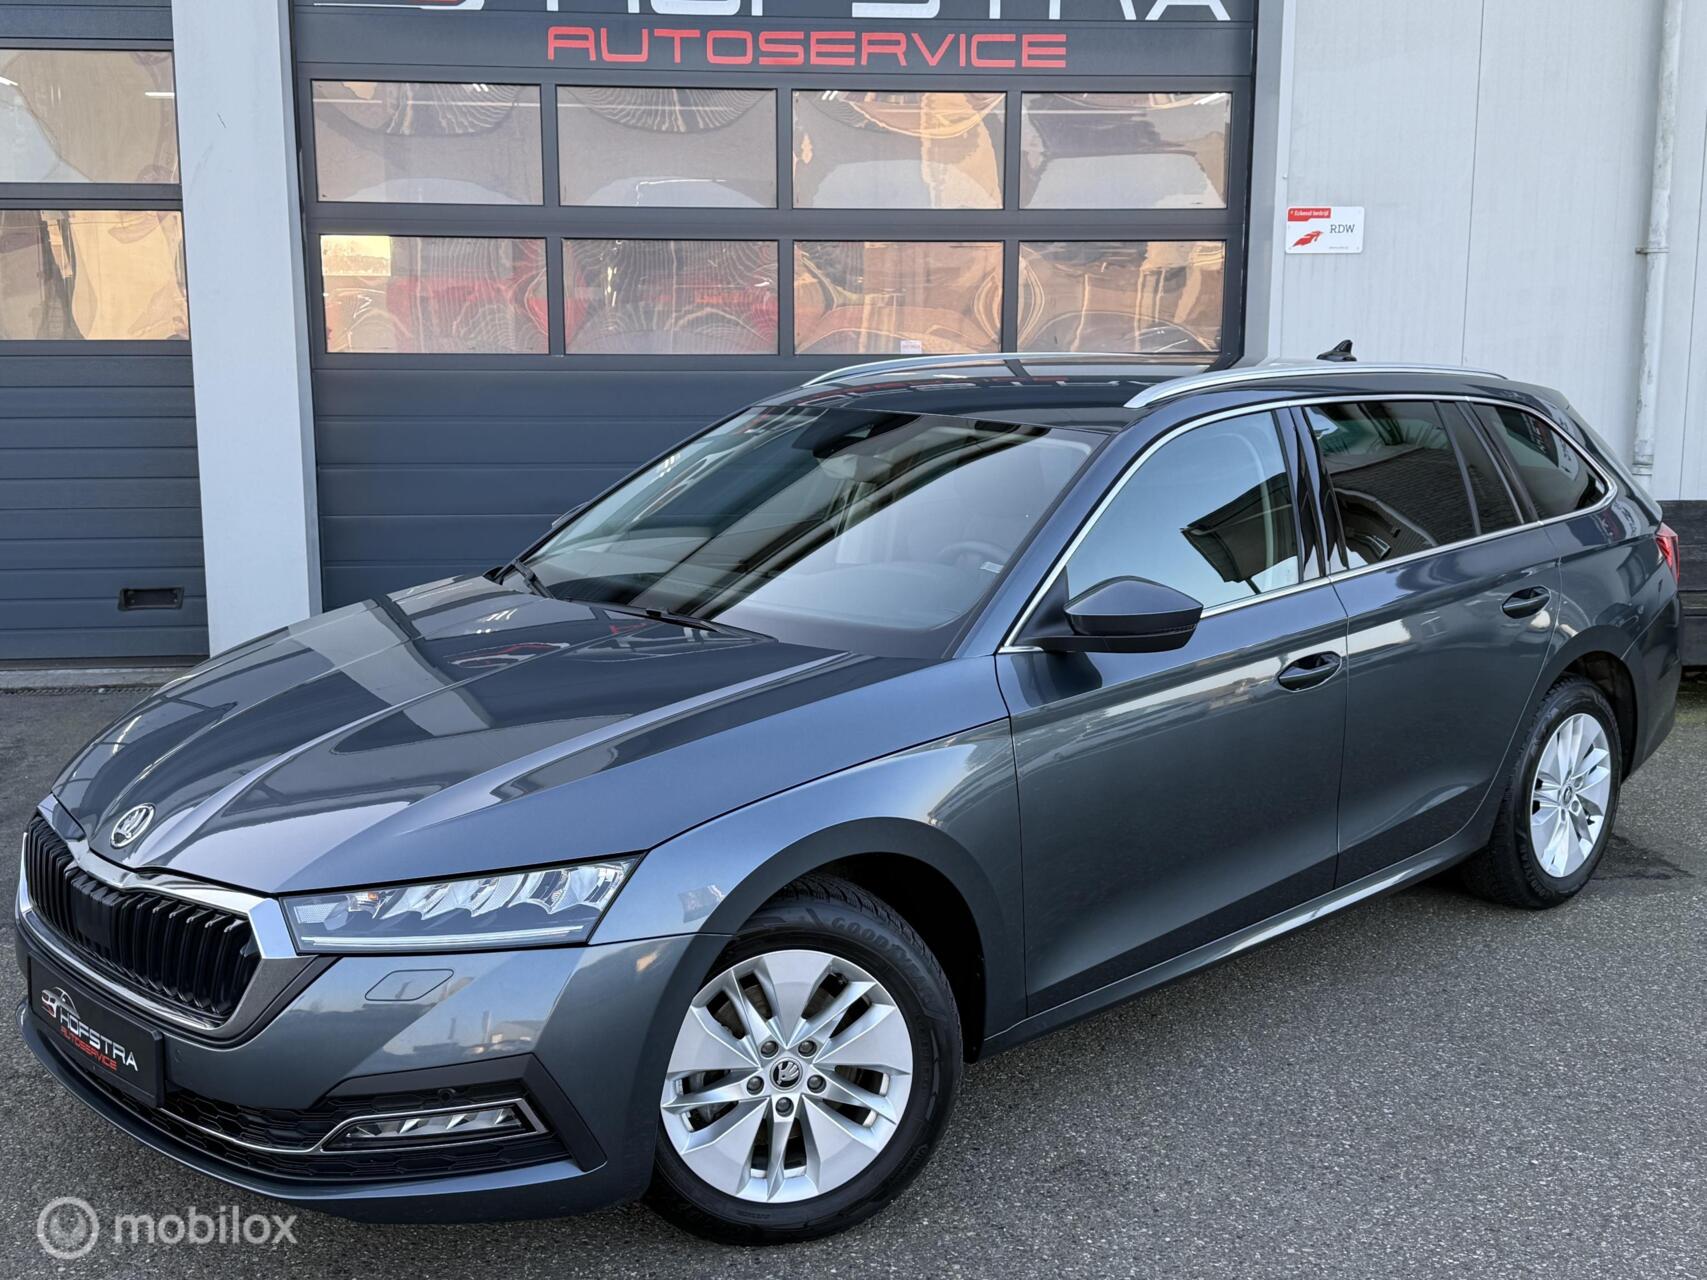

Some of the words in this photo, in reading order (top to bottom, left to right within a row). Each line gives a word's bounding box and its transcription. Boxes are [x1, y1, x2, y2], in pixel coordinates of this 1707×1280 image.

[547, 26, 1067, 68] AUTOSERVICE
[1329, 224, 1355, 233] RDW
[60, 1006, 138, 1072] HOFSTRA
[60, 1025, 118, 1072] AUTOSERVICE
